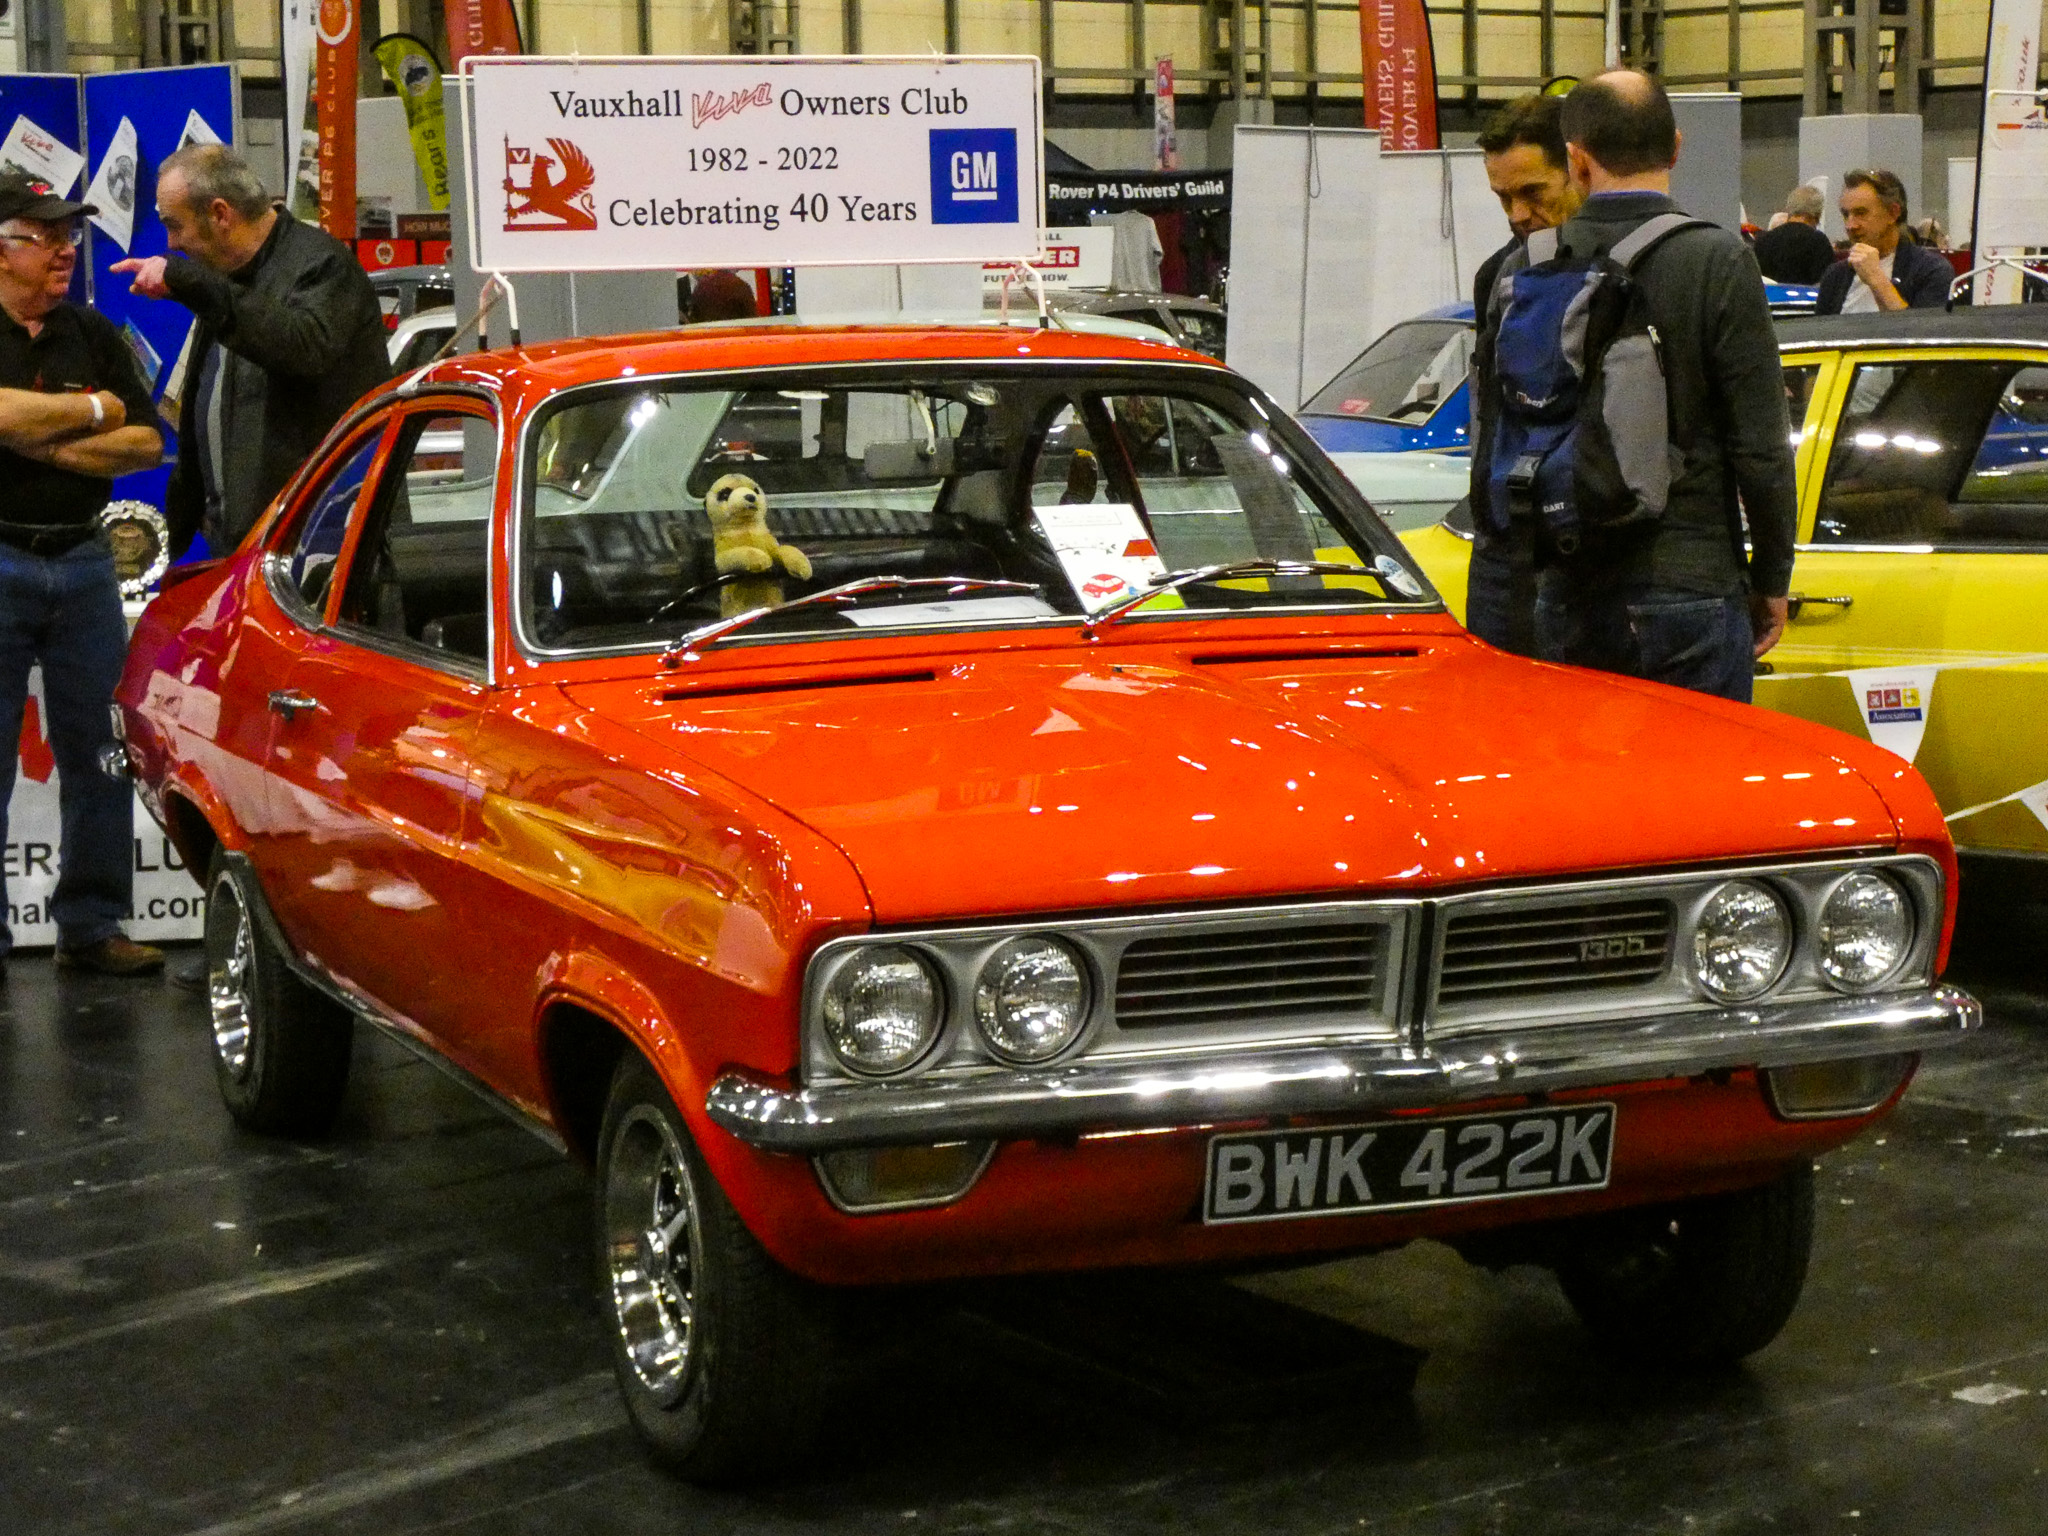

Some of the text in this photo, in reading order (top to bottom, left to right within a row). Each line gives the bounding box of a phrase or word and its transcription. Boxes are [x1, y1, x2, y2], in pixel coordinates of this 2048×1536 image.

[550, 83, 968, 129] Vauxhall Viva Owners Club
[688, 147, 748, 171] 1982
[777, 146, 839, 170] 2022
[951, 151, 998, 190] GM
[1049, 180, 1225, 199] Rover P4 Drivers' Guild
[609, 193, 917, 231] Celebrating 40 Years
[1543, 502, 1565, 513] DART
[1580, 936, 1645, 962] 1300
[1214, 1113, 1608, 1215] BWK 422K
